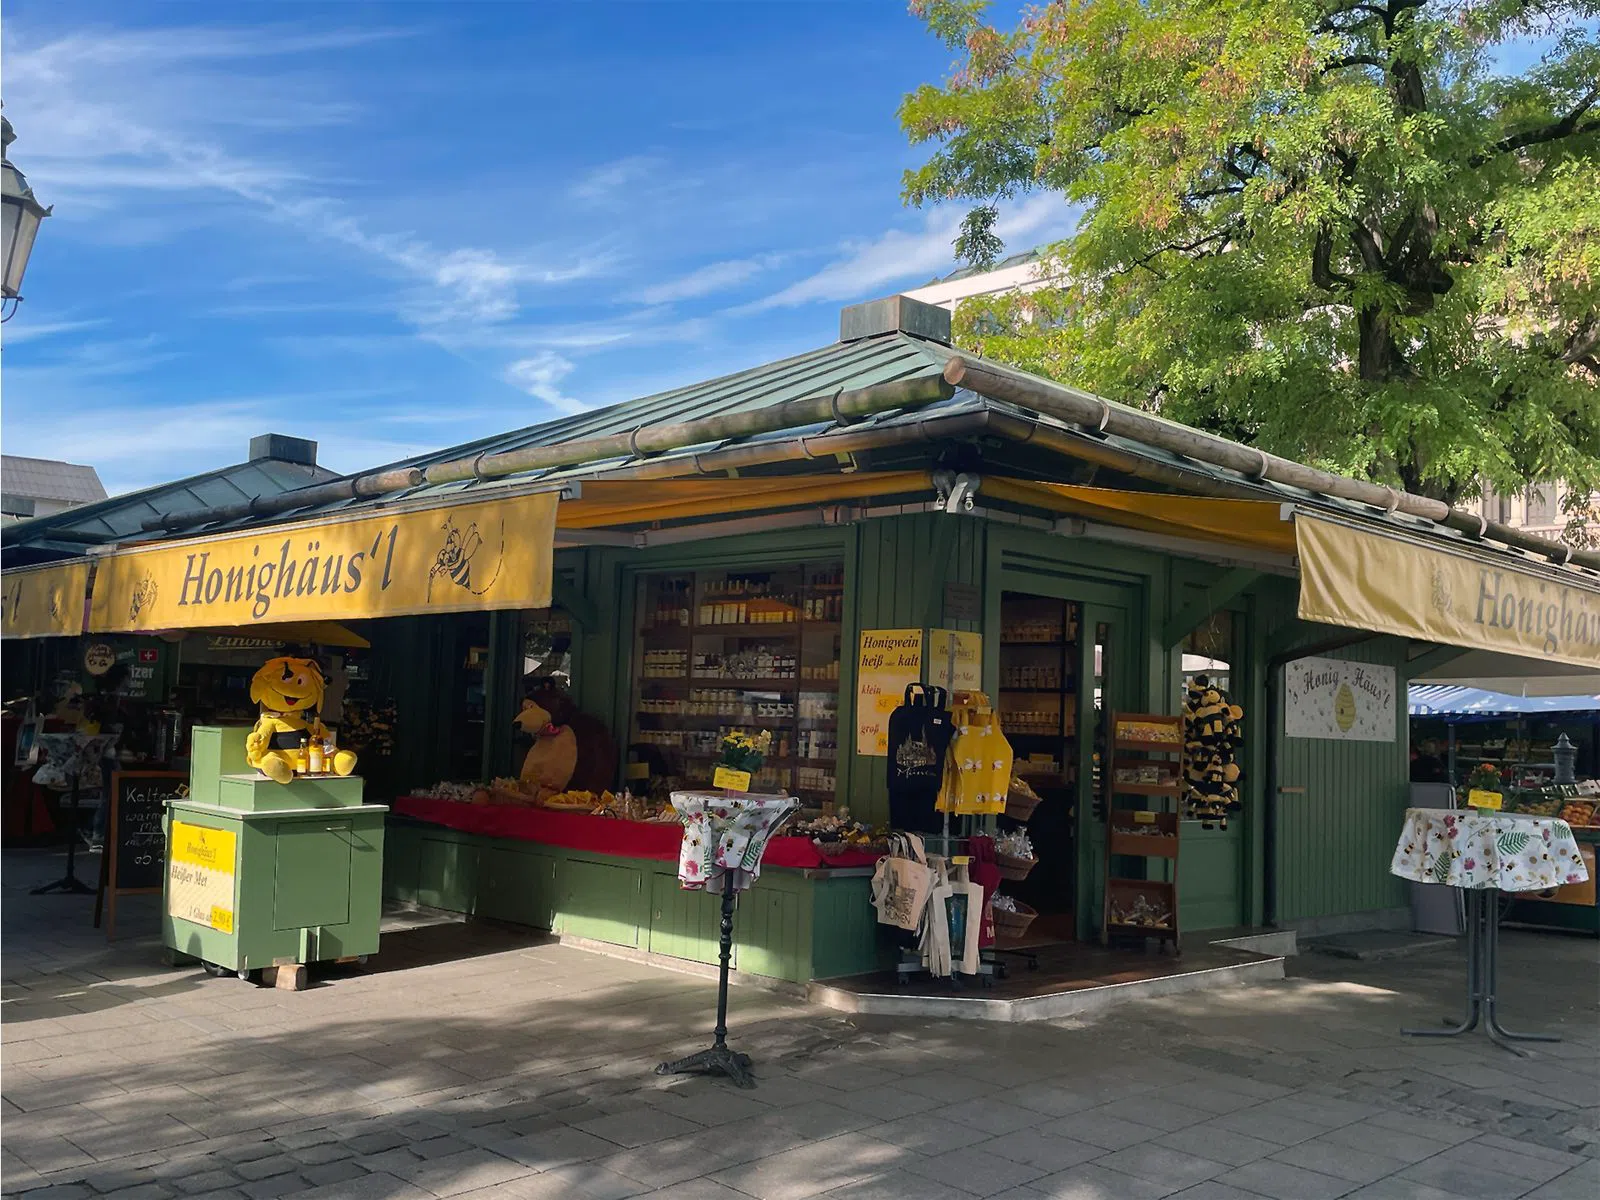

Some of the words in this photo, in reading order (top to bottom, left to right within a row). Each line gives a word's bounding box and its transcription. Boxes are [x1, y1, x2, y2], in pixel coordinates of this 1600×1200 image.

[863, 635, 919, 651] Honigwein
[861, 654, 884, 669] heiß
[897, 654, 919, 667] kalt
[1303, 667, 1339, 695] Honig
[861, 684, 881, 696] klein
[171, 864, 193, 885] Heißer
[194, 869, 208, 887] Met
